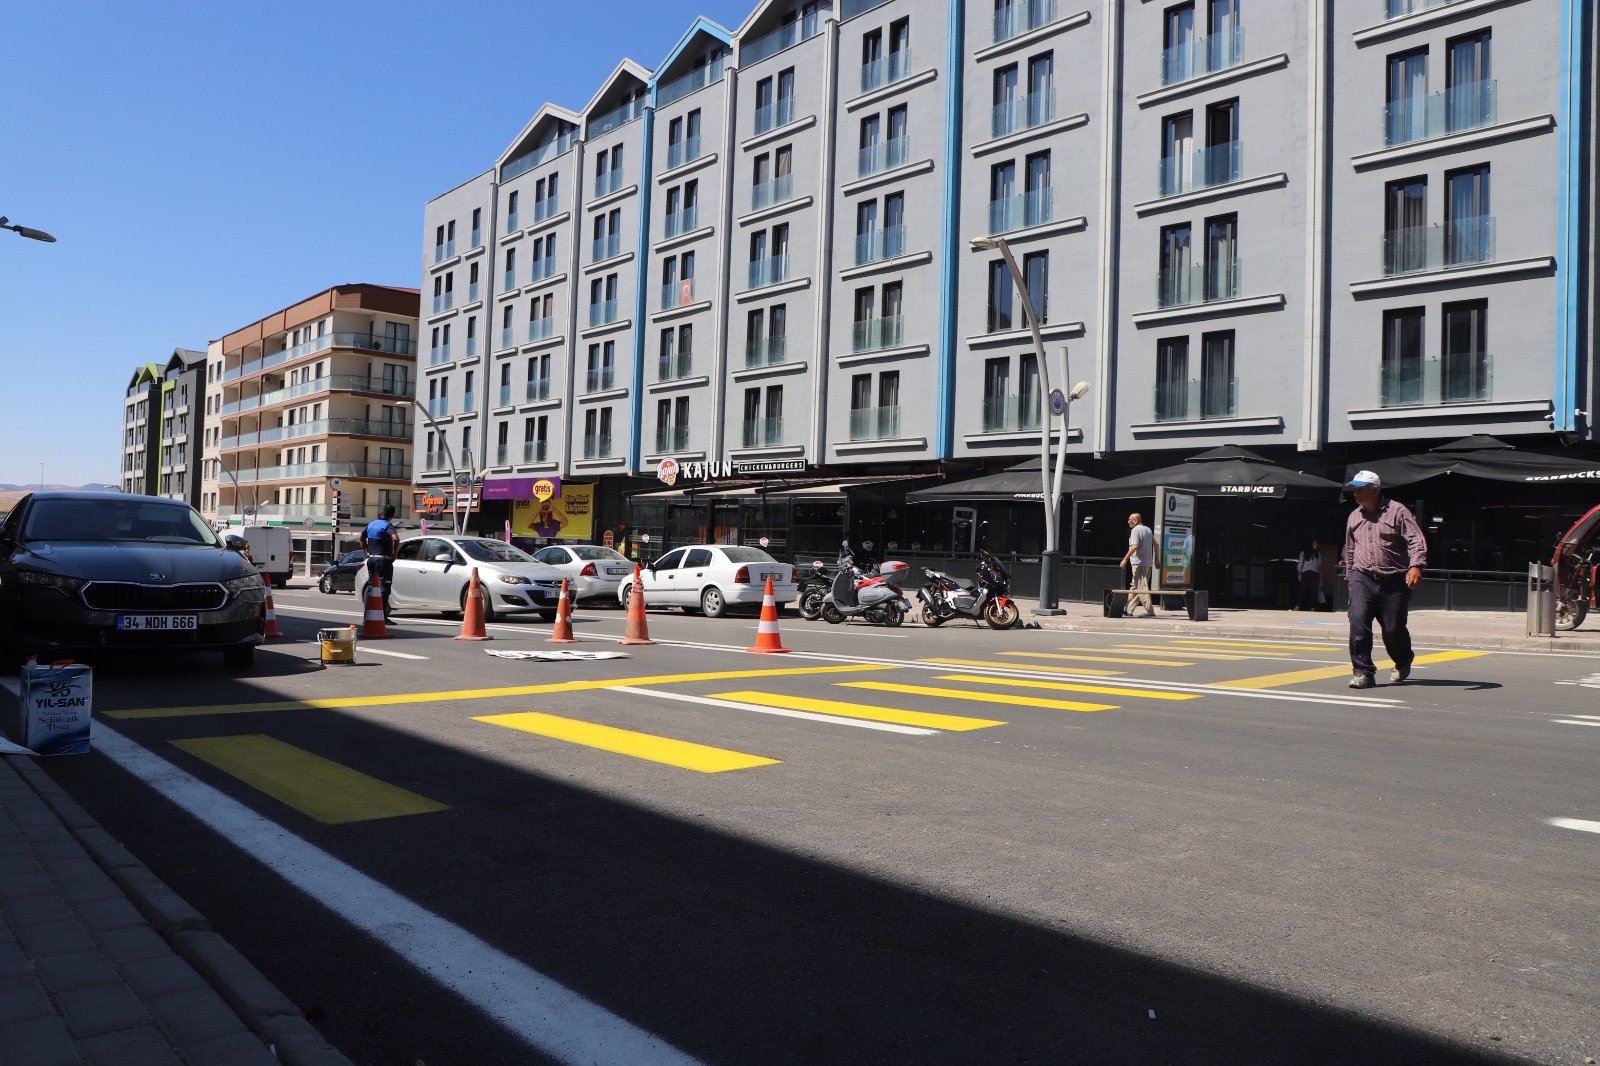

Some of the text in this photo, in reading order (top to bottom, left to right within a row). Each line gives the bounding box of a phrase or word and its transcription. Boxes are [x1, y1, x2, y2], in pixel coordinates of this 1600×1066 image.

[683, 460, 732, 481] KAJUN
[534, 482, 551, 495] gratis
[1220, 485, 1275, 494] STARBUCKS
[124, 617, 194, 629] 34 NDH 666
[35, 698, 85, 708] YIL-SAN
[38, 715, 80, 724] Selülozik
